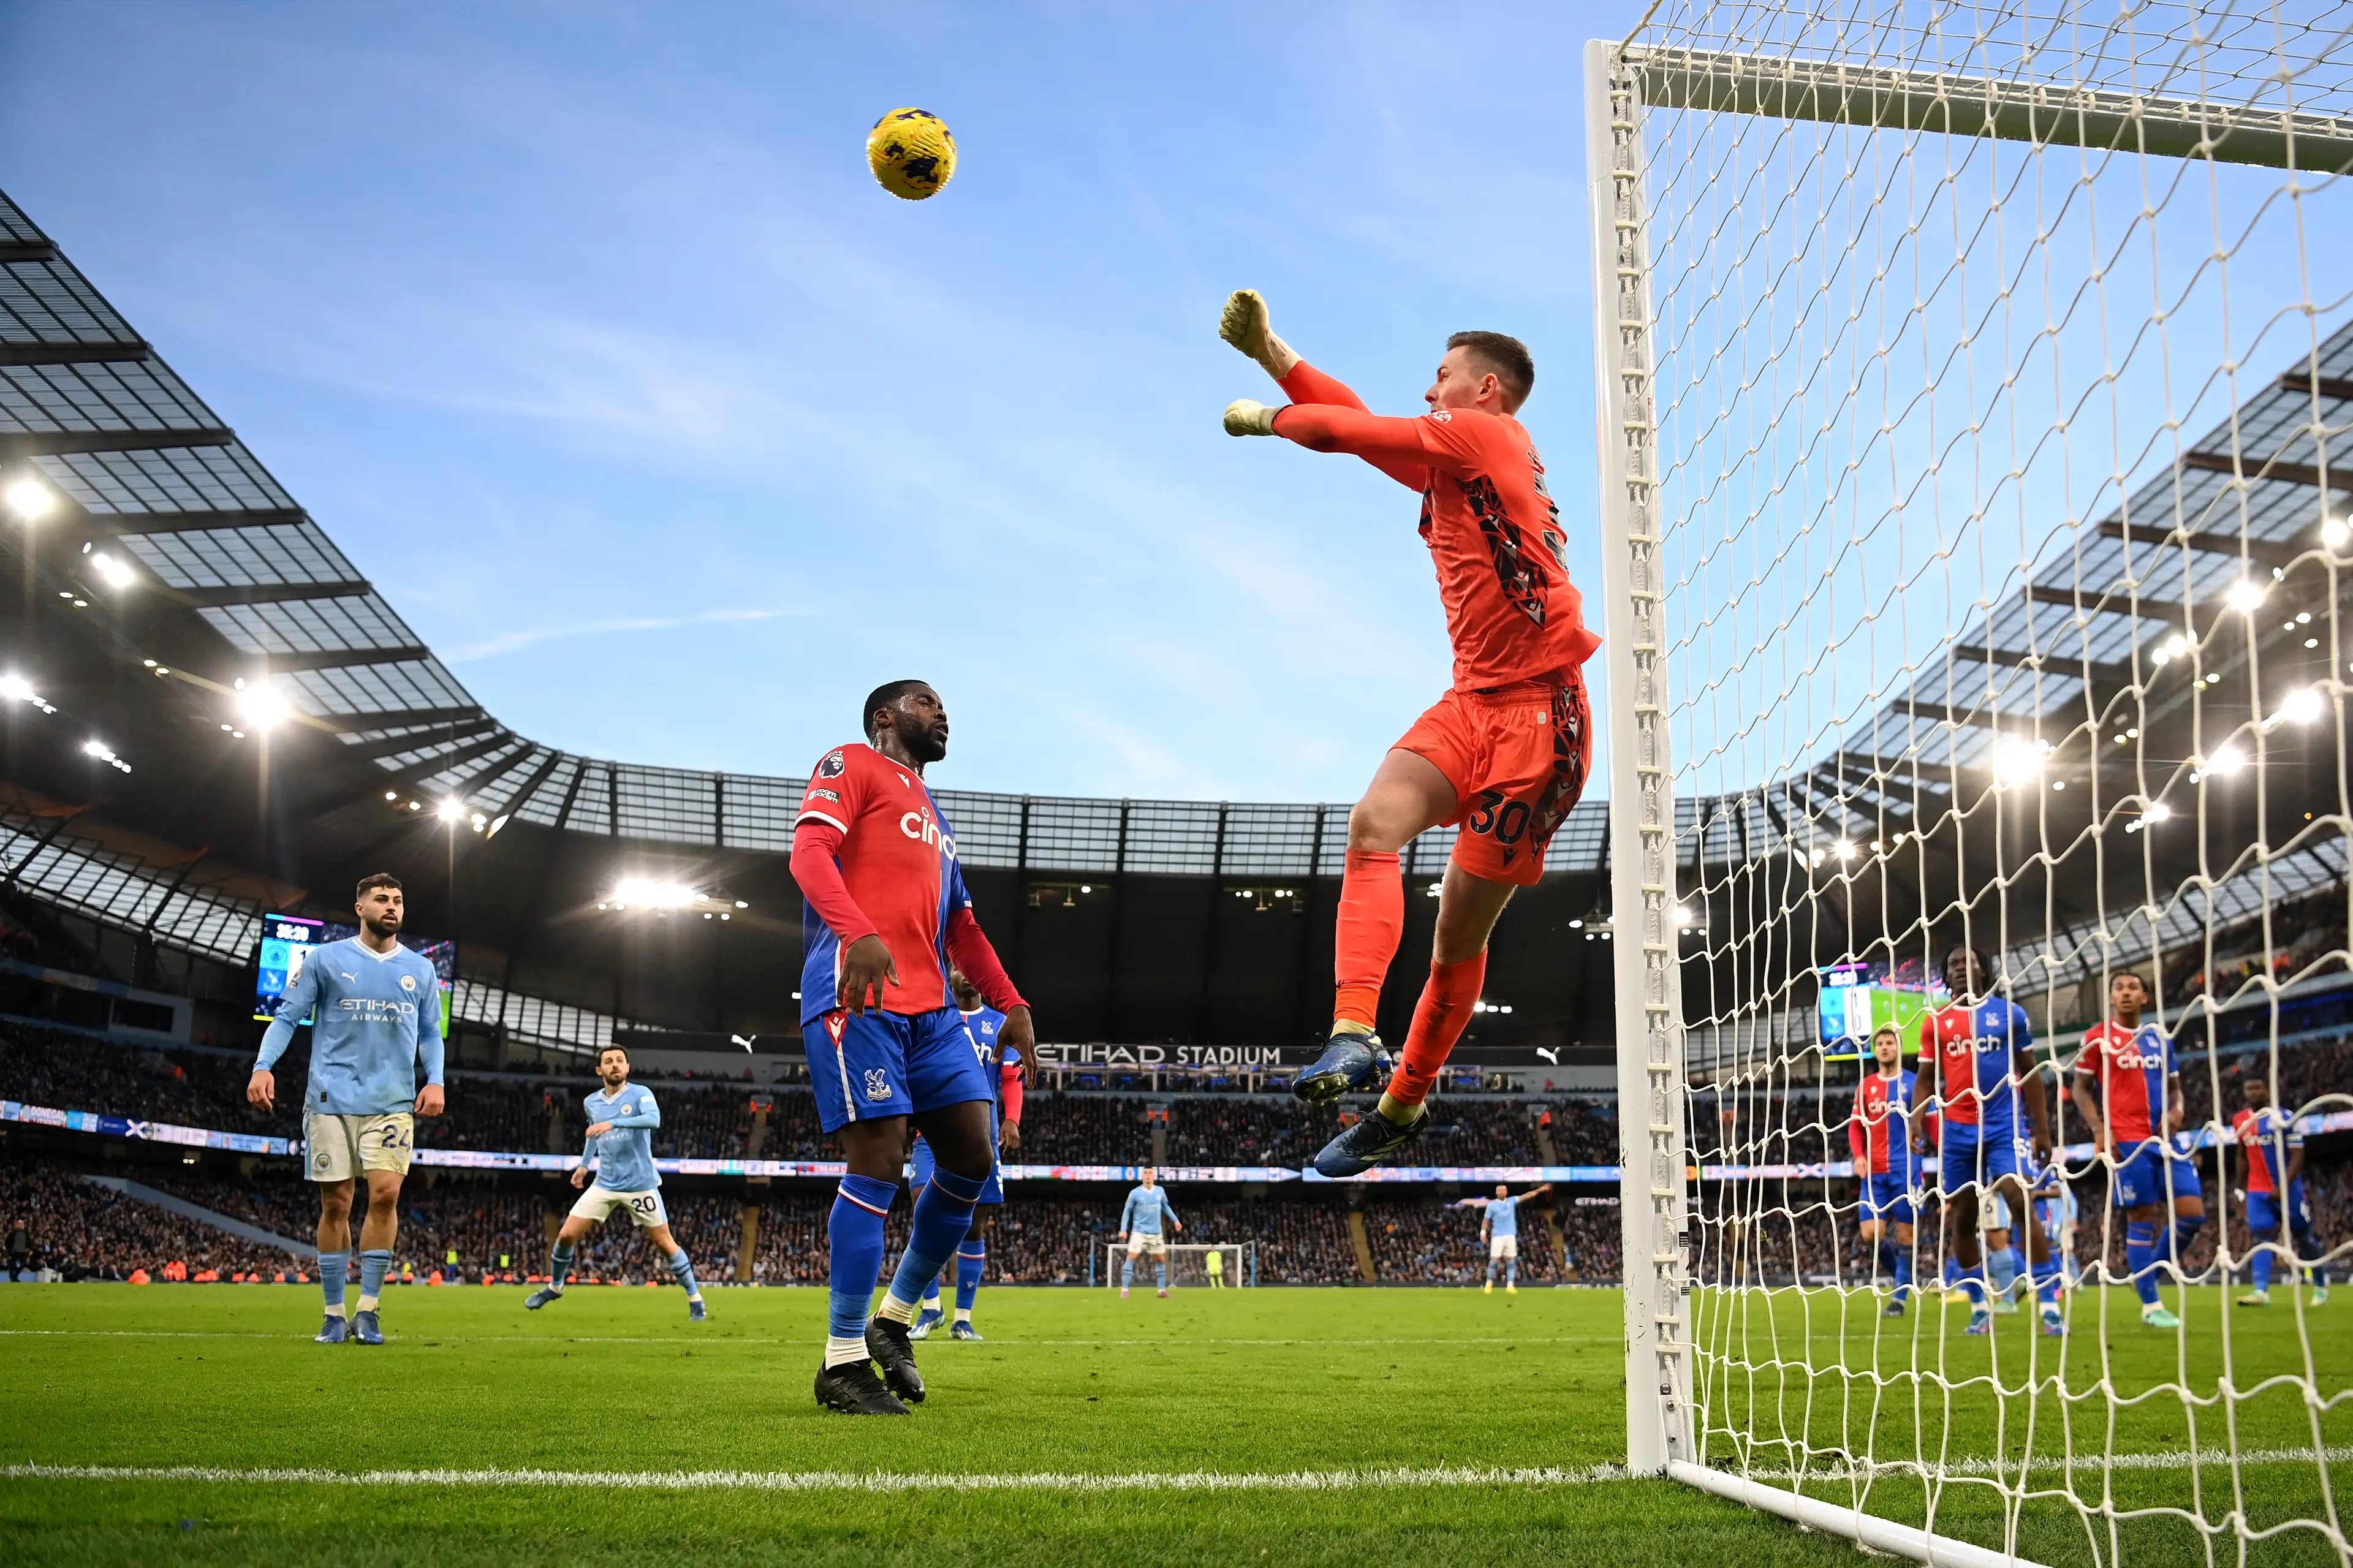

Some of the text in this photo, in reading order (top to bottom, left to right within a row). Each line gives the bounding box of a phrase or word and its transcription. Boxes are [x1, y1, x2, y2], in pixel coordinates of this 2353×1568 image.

[1469, 789, 1531, 845] 30
[900, 806, 957, 860] cinc
[339, 998, 415, 1015] ETIHAD
[350, 1013, 403, 1023] AIRWAYS
[1034, 1043, 1281, 1064] ETIHAD STADIUM
[1946, 1034, 2002, 1056] cinch
[381, 1124, 411, 1153] 24
[631, 1195, 657, 1213] 20
[1575, 1197, 1620, 1206] ETIHAD
